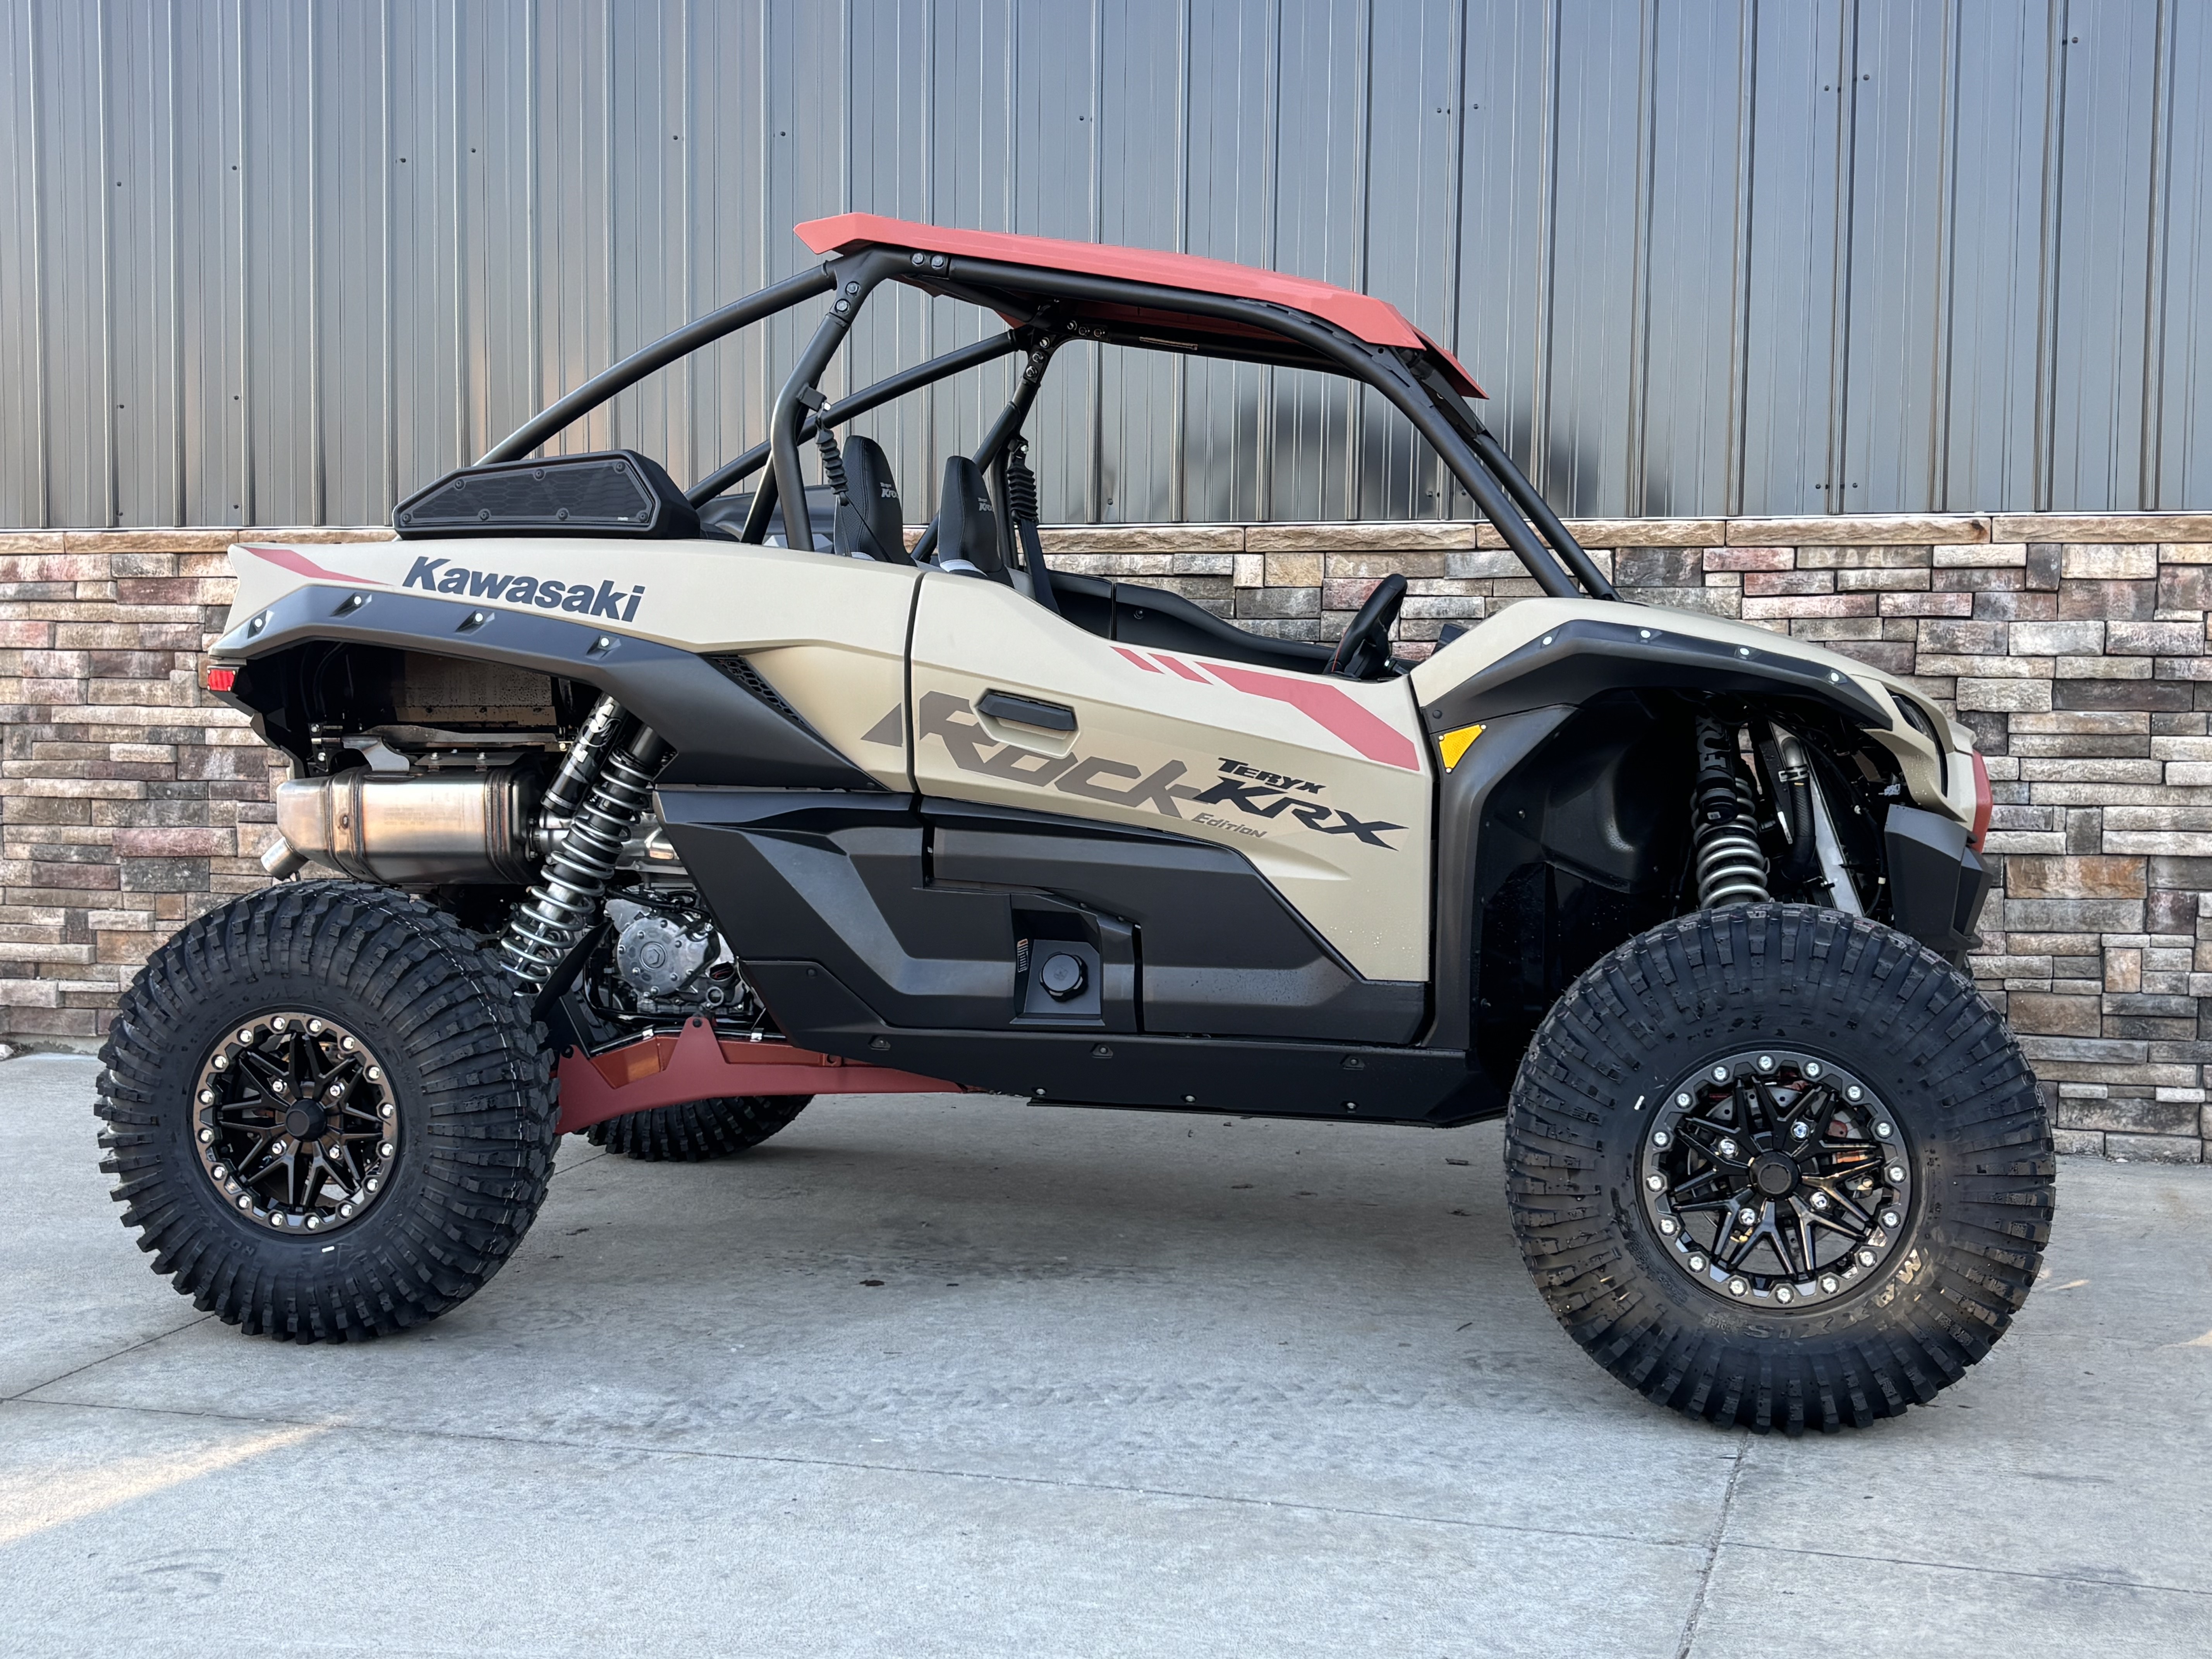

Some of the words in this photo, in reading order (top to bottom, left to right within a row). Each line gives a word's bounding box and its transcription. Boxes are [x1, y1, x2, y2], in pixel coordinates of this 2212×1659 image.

[402, 556, 646, 622] Kawasaki
[1695, 715, 1731, 771] FOX
[1193, 775, 1410, 852] KRX
[1745, 1248, 1922, 1340] MAXXIS
